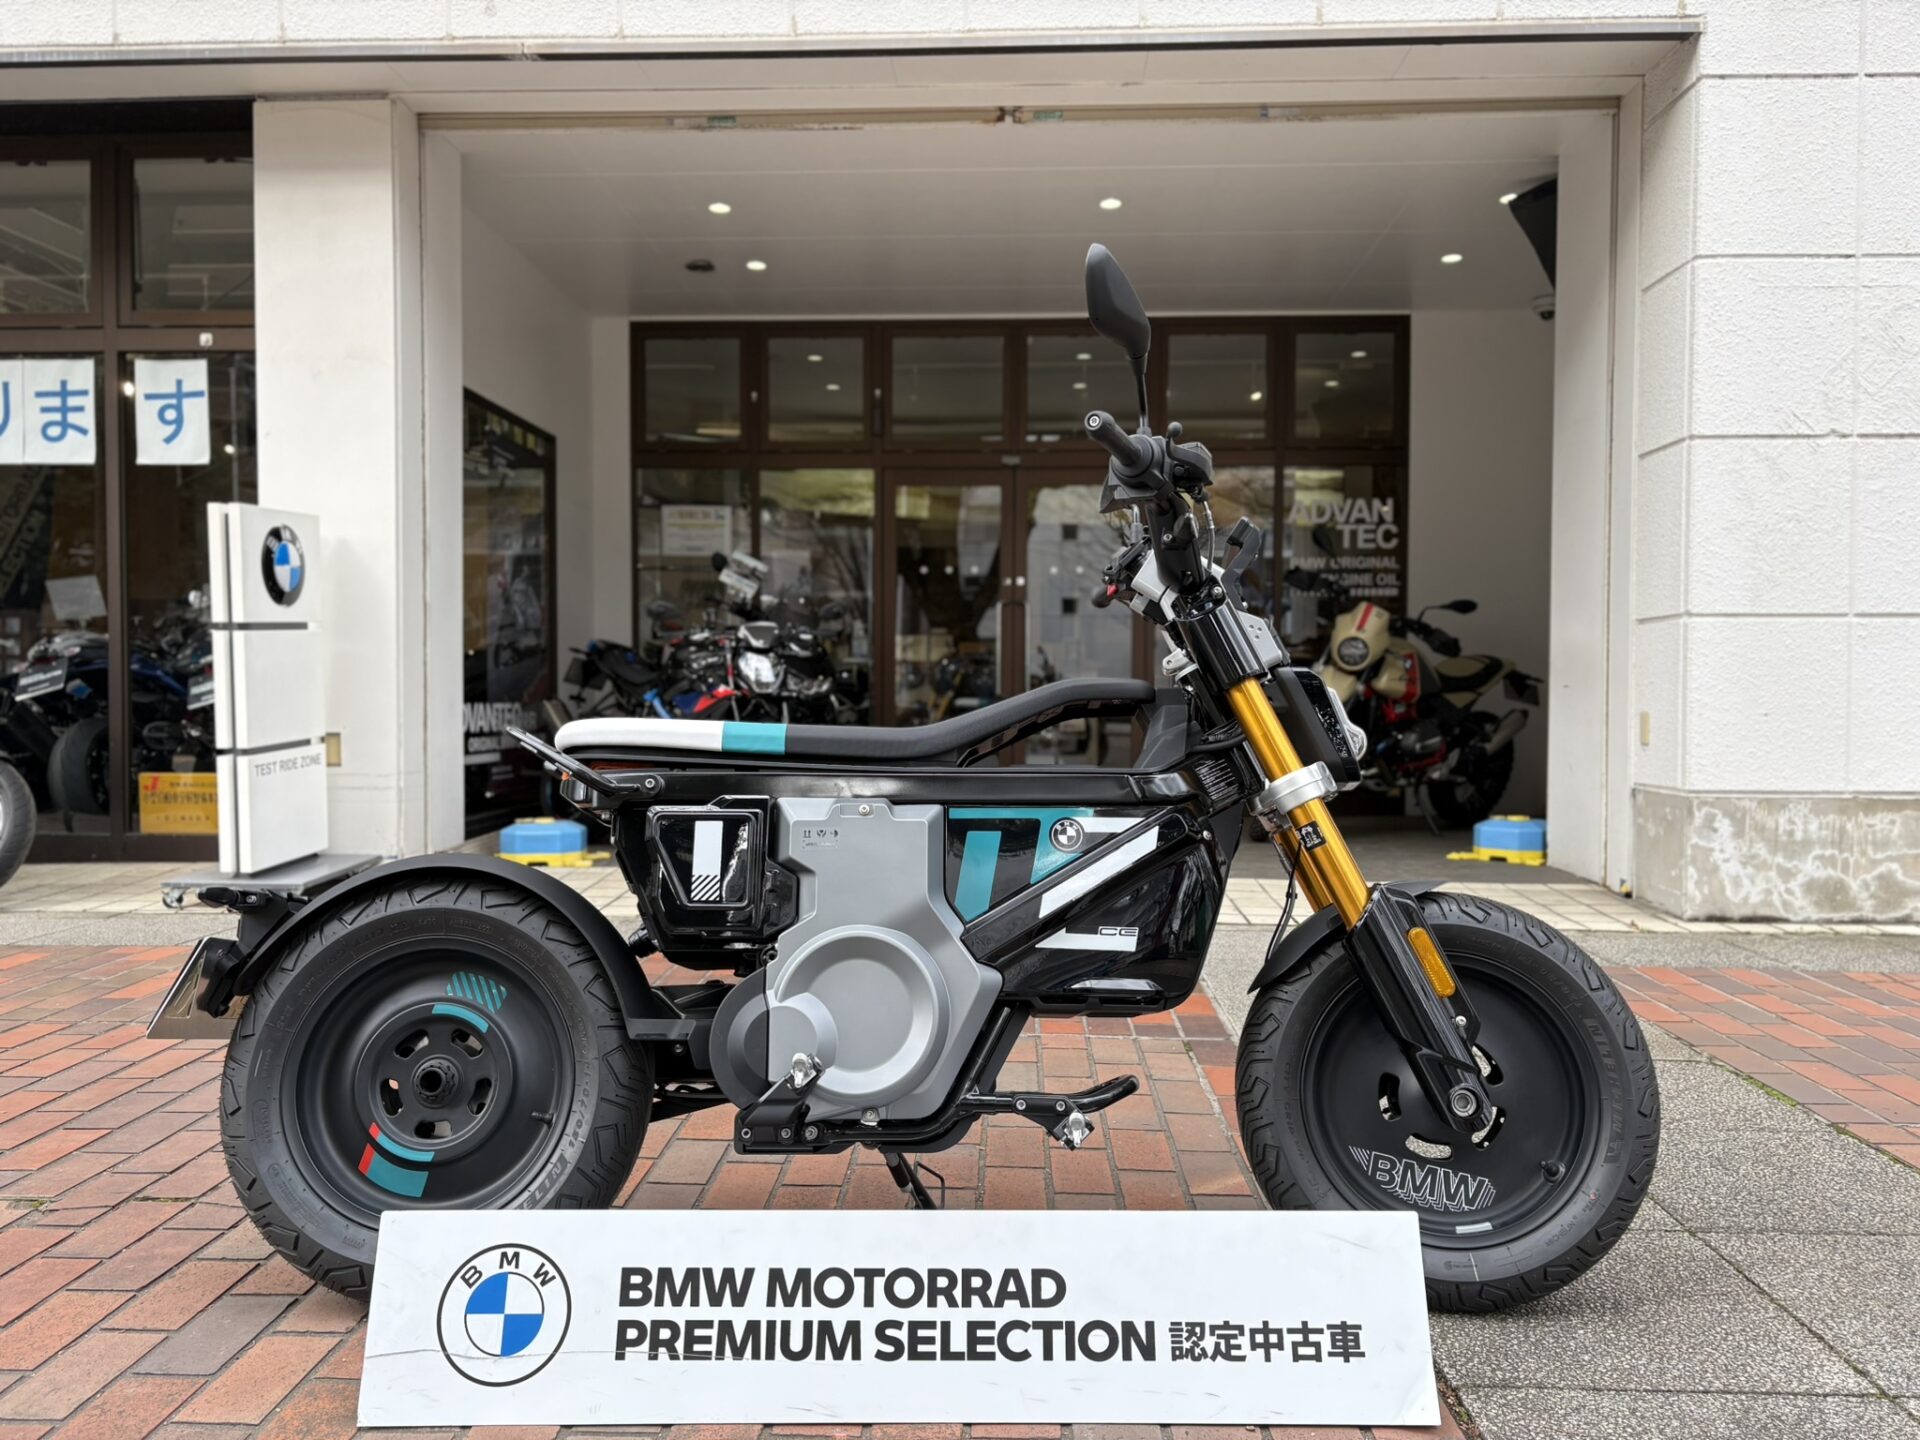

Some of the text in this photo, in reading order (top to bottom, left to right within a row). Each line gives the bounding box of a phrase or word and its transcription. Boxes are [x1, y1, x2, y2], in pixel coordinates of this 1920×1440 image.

[1287, 497, 1395, 524] ADVAN
[1336, 524, 1399, 549] TEC
[254, 753, 322, 777] TEST RIDE ZONE
[1099, 927, 1138, 937] CE
[521, 1160, 564, 1209] ELIN
[1367, 1150, 1496, 1212] BMW
[460, 1250, 558, 1289] BMW
[618, 1266, 1067, 1309] BMW MOTORRAD
[614, 1319, 1366, 1364] PREMIUM SELECTION 認定中古車
